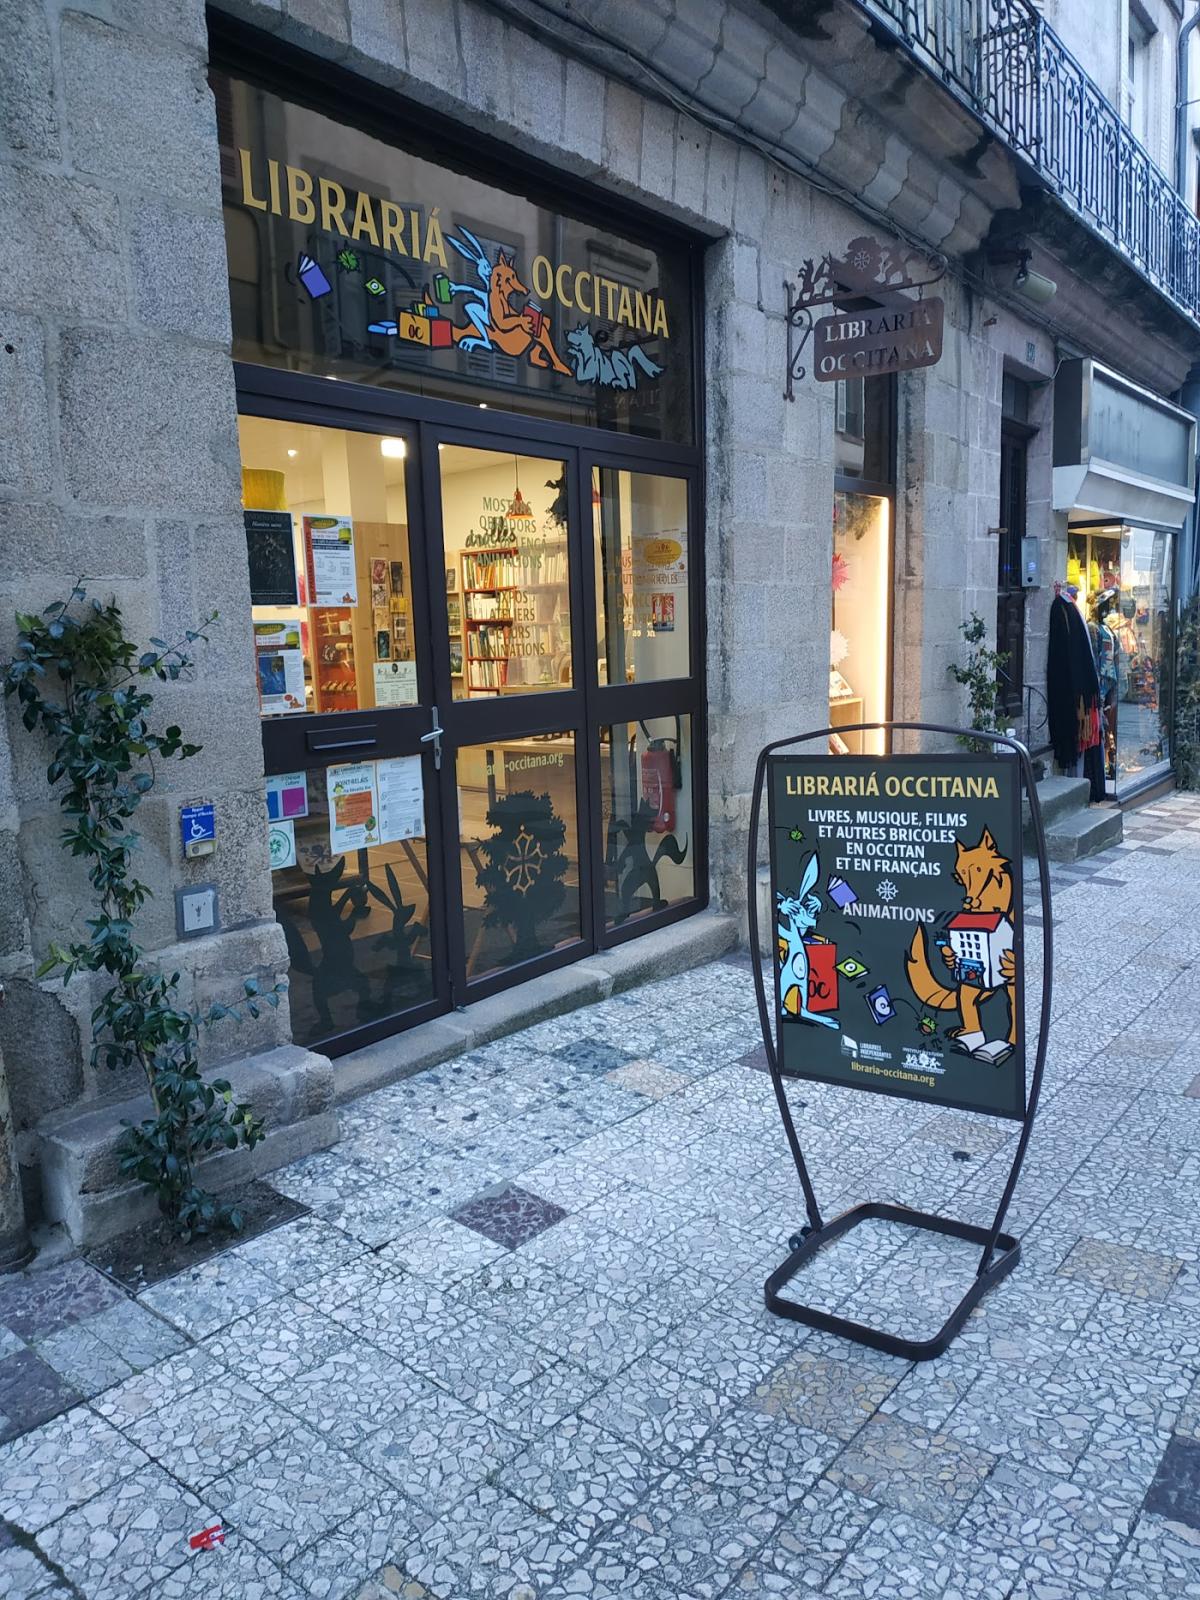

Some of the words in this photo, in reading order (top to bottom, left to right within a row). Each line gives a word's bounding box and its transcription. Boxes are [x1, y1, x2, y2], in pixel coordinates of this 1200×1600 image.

[239, 148, 449, 268] LIBRARIÁ
[531, 255, 670, 339] OCCITANA
[820, 340, 936, 373] OCCITANA
[786, 772, 880, 797] LIBRARIÁ
[885, 776, 1000, 799] OCCITANA
[808, 809, 854, 825] LIVRES,
[856, 810, 923, 827] MUSIQUE,
[925, 812, 968, 827] FILMS
[818, 825, 834, 838] ET
[836, 826, 886, 841] AUTRES
[889, 828, 956, 844] BRICOLES
[846, 842, 864, 855] EN
[866, 843, 925, 859] OCCITAN
[836, 857, 852, 870] ET
[854, 858, 872, 872] EN
[874, 859, 941, 878] FRANÇAIS
[843, 902, 936, 923] ANIMATIONS
[851, 1061, 935, 1087] libraria-occitana.org
